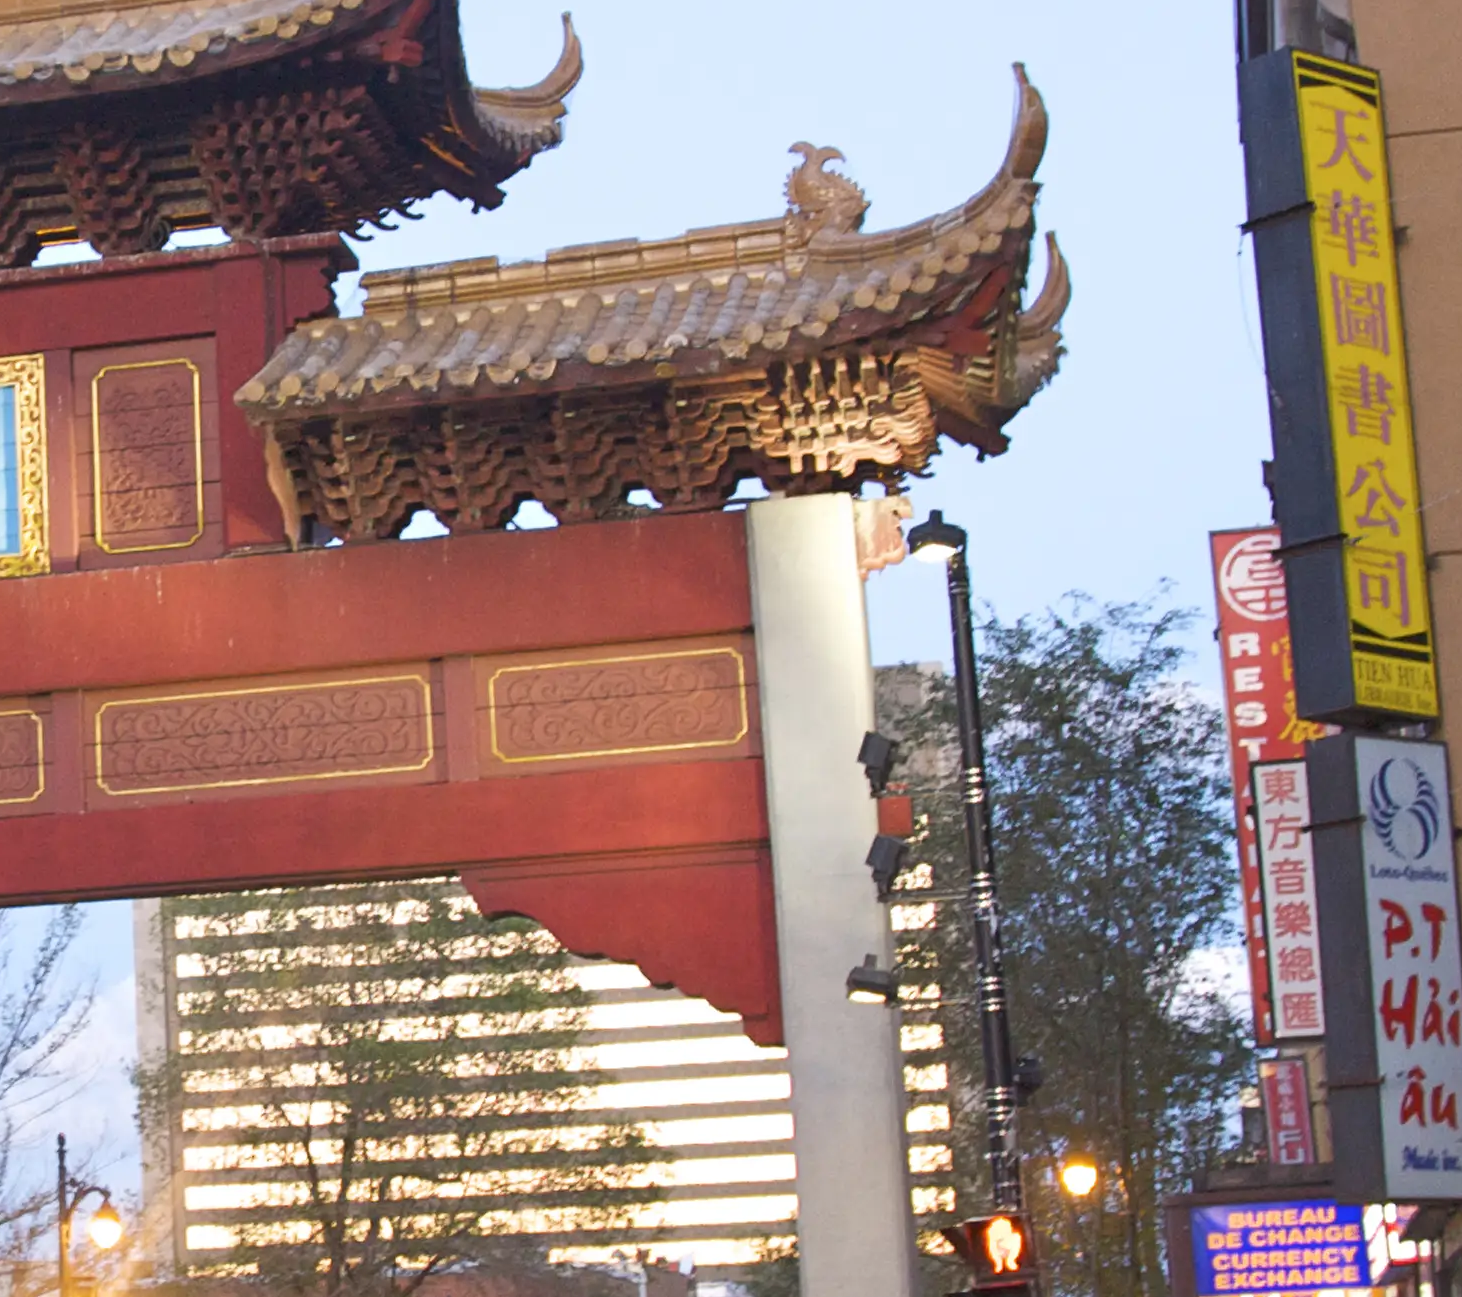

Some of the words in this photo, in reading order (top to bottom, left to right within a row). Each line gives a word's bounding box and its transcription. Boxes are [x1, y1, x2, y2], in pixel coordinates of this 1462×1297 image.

[1312, 101, 1411, 629] 天華圖書公司
[1354, 658, 1392, 685] TIEN
[1396, 663, 1433, 691] HUA
[1260, 768, 1322, 1031] 東方音樂總匯
[1227, 1206, 1336, 1229] BUREAU
[1207, 1232, 1243, 1250] DE
[1248, 1223, 1361, 1246] CHANGE
[1212, 1245, 1358, 1271] CURRENCY
[1213, 1265, 1361, 1290] EXCHANGE
